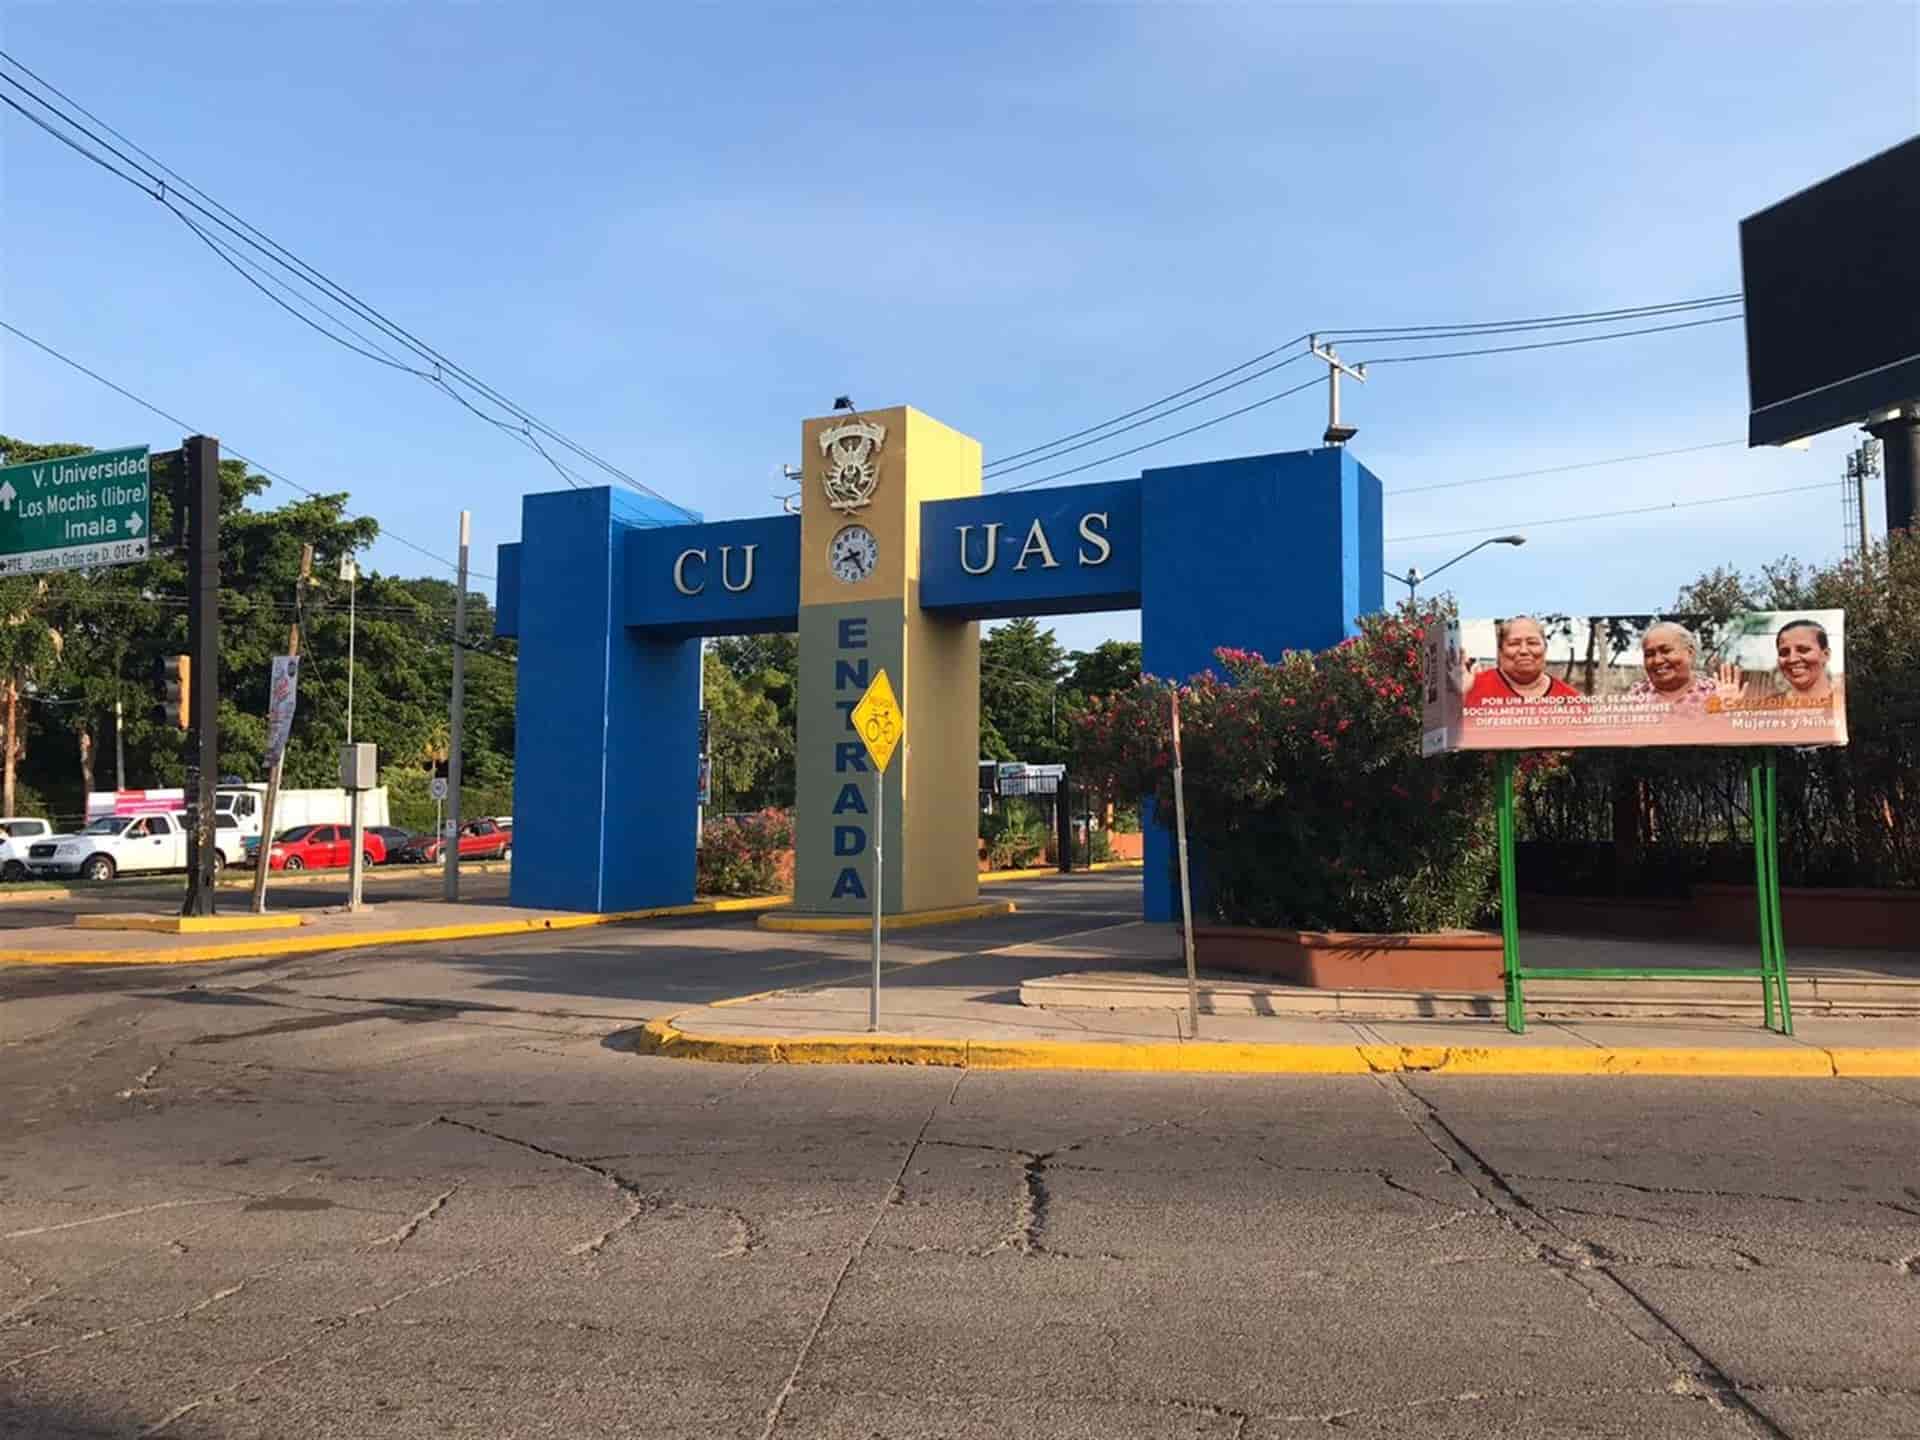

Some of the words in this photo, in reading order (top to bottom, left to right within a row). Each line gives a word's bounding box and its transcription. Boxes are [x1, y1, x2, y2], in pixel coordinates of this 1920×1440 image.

[32, 469, 48, 488] V.
[52, 454, 147, 485] Universidad
[18, 499, 43, 518] Los
[47, 491, 97, 513] Mochis
[102, 483, 146, 507] (libre)
[65, 516, 117, 539] Imala
[957, 512, 1113, 575] UAS
[673, 544, 758, 595] CU
[1463, 706, 1537, 717] SOCIALMENTE
[1481, 696, 1504, 706] POR
[1523, 695, 1565, 705] MUNDO
[1732, 718, 1787, 730] Mujeres
[1792, 719, 1799, 730] y
[831, 617, 868, 899] ENTRADA
